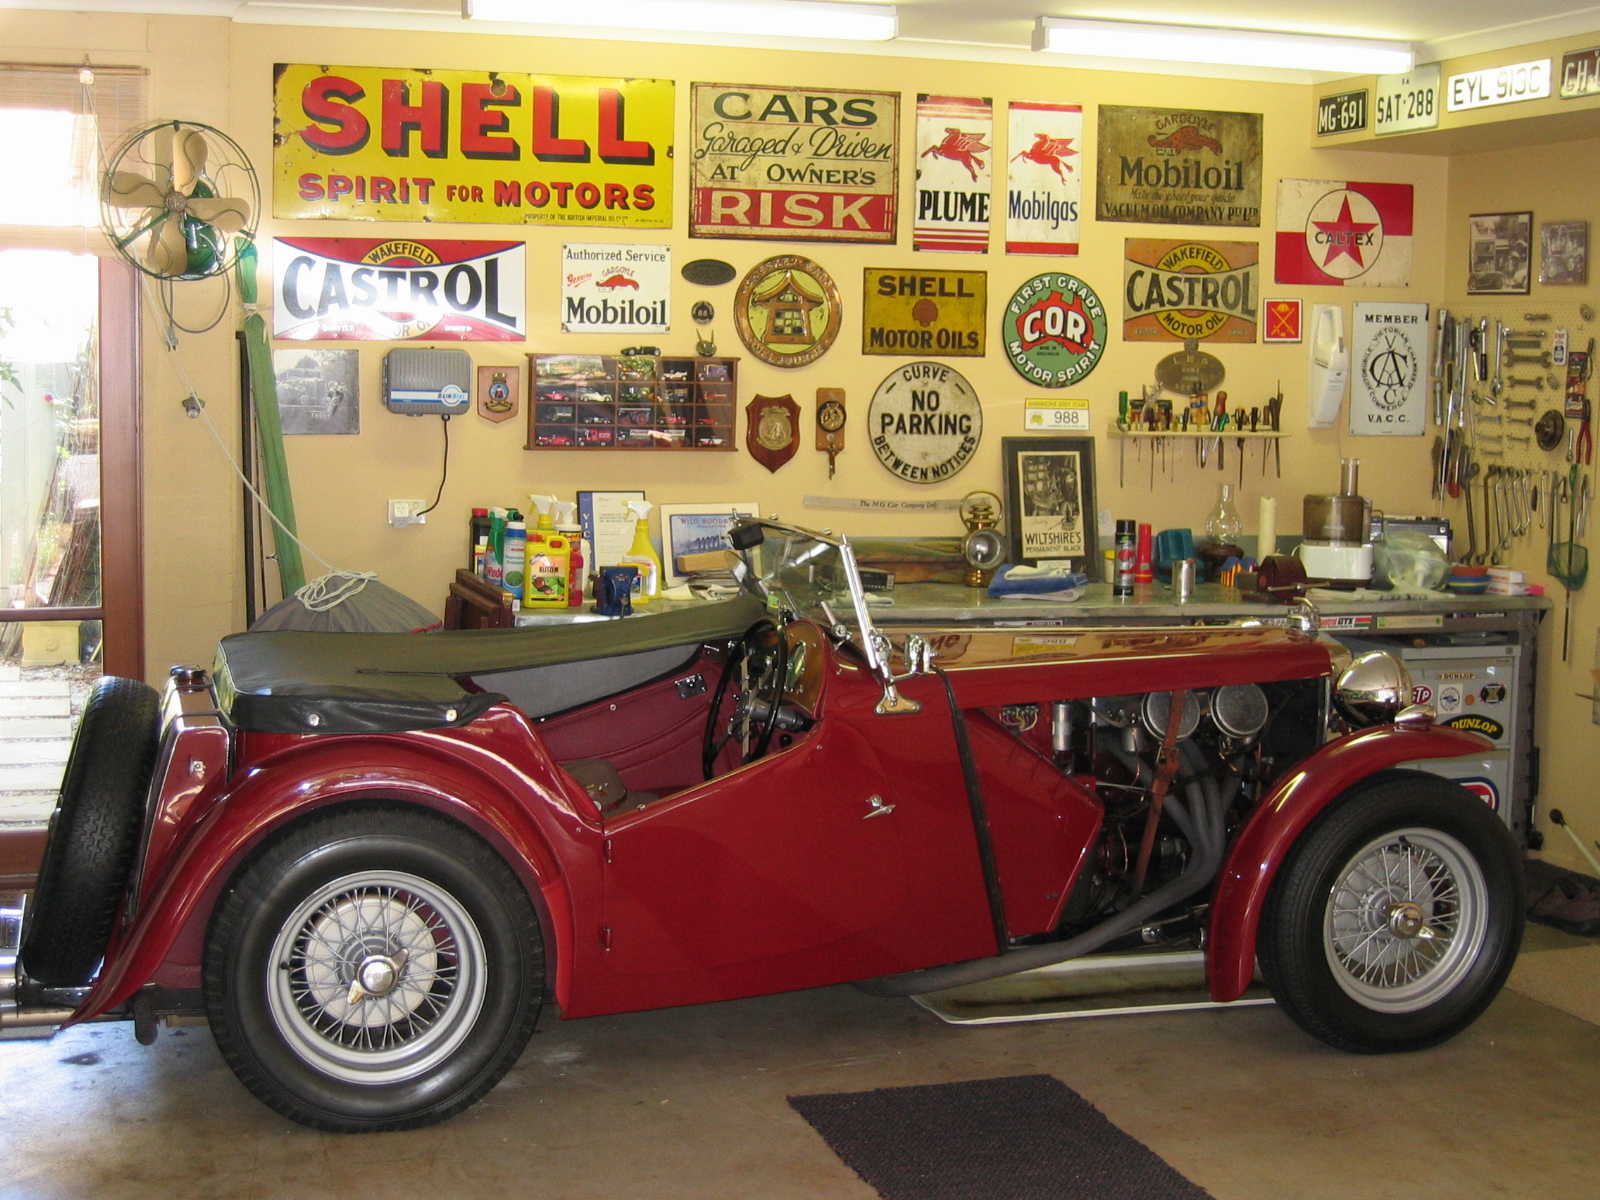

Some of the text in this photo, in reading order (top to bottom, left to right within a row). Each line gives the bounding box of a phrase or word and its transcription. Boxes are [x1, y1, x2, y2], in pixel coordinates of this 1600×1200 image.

[1454, 66, 1540, 105] EYL 913C
[300, 75, 654, 165] SHELL
[713, 92, 878, 126] CARS
[1156, 113, 1215, 134] GARGOYLE
[694, 121, 800, 171] Garaged
[809, 126, 893, 160] Driven
[710, 163, 876, 185] AT OWNER'S
[1118, 156, 1244, 190] Mobiloil
[298, 172, 654, 210] SPIRIT FOR MOTORS
[710, 190, 874, 230] RISK
[918, 190, 990, 222] PLUME
[1009, 190, 1078, 230] Mobilgas
[1104, 202, 1149, 217] VACUUM
[1174, 204, 1226, 221] COMPANY
[1315, 231, 1375, 246] CALTEX
[368, 242, 434, 265] WAKEFIELD
[566, 249, 666, 262] Authorized Service
[1162, 246, 1224, 271] WAKEFIELD
[602, 265, 635, 277] GARGOYLE
[282, 255, 516, 328] CASTROL
[877, 274, 974, 298] SHELL
[1011, 276, 1102, 318] FIRST GRADE
[1126, 270, 1255, 319] CASTROL
[566, 296, 667, 325] Mobiloil
[1364, 314, 1418, 324] MEMBER
[1023, 305, 1087, 347] C.O.R.
[1163, 313, 1225, 336] MOTOR OIL
[1373, 327, 1409, 344] VICTORIAN
[870, 327, 979, 350] MOTOR OILS
[1010, 340, 1101, 382] MOTOR SPIRIT
[903, 365, 949, 383] CURVE
[912, 390, 940, 411] NO
[1370, 391, 1407, 411] COMMERCE
[881, 413, 972, 435] PARKING
[1054, 411, 1079, 424] 988
[874, 434, 976, 480] BETWEEN NOTICES
[901, 501, 925, 509] Company
[1025, 531, 1081, 545] WILTSHIRE'S
[1337, 617, 1353, 625] GTX
[1451, 718, 1498, 734] DUNLOP
